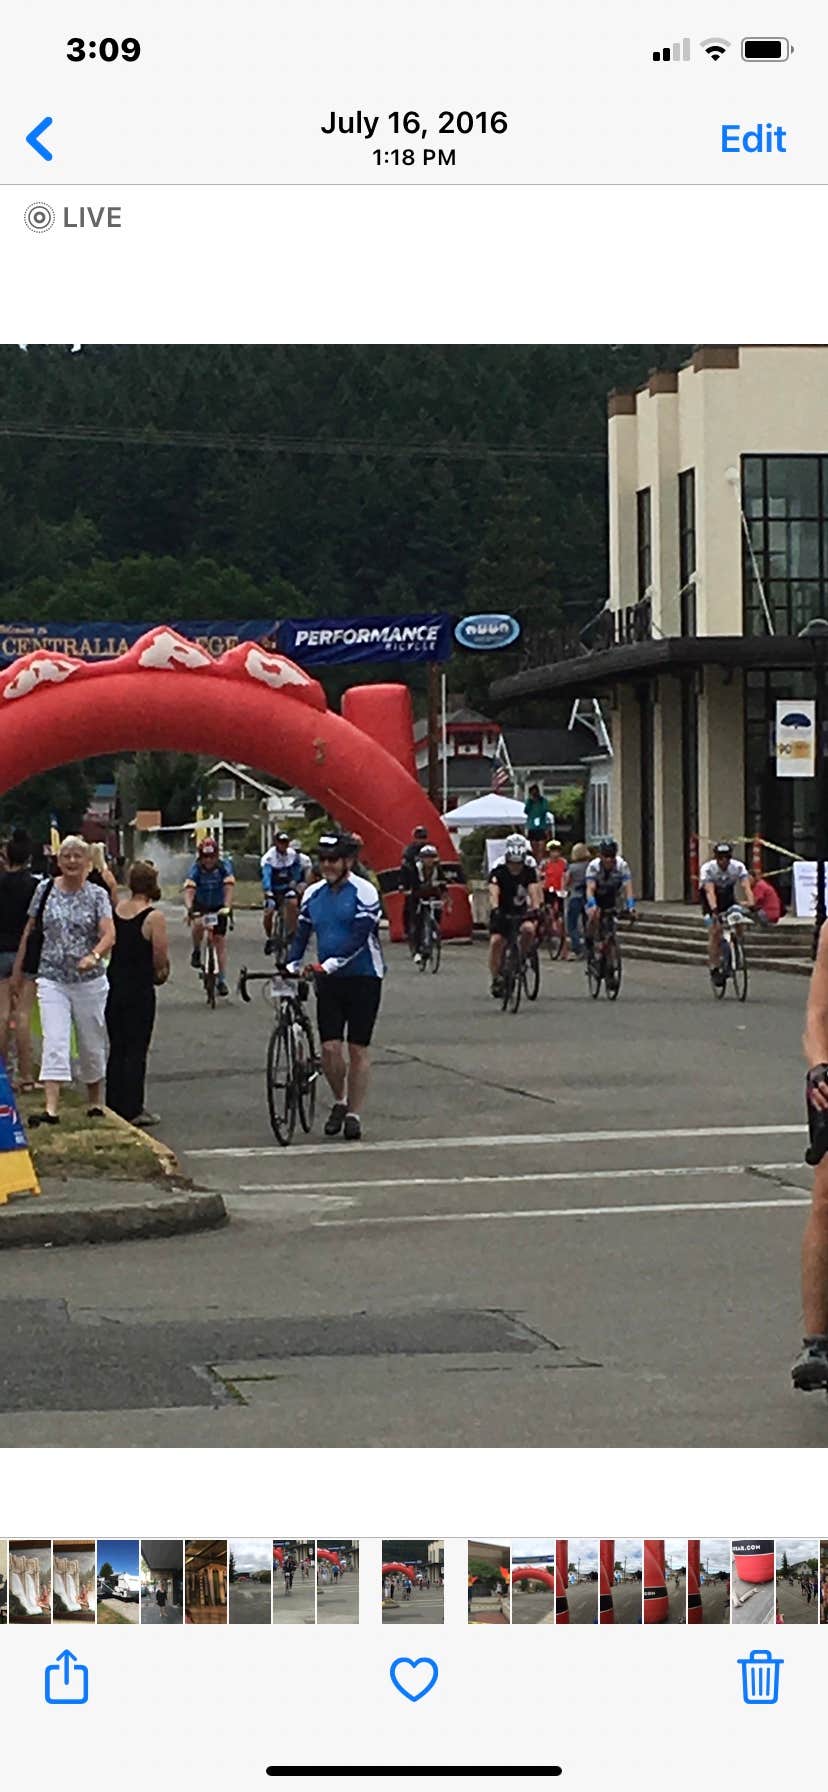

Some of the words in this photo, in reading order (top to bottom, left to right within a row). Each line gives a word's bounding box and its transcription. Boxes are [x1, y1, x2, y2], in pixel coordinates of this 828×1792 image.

[295, 626, 440, 646] PERFORMANCE
[2, 637, 129, 656] CENTRALIA
[385, 642, 435, 651] BICYCLE
